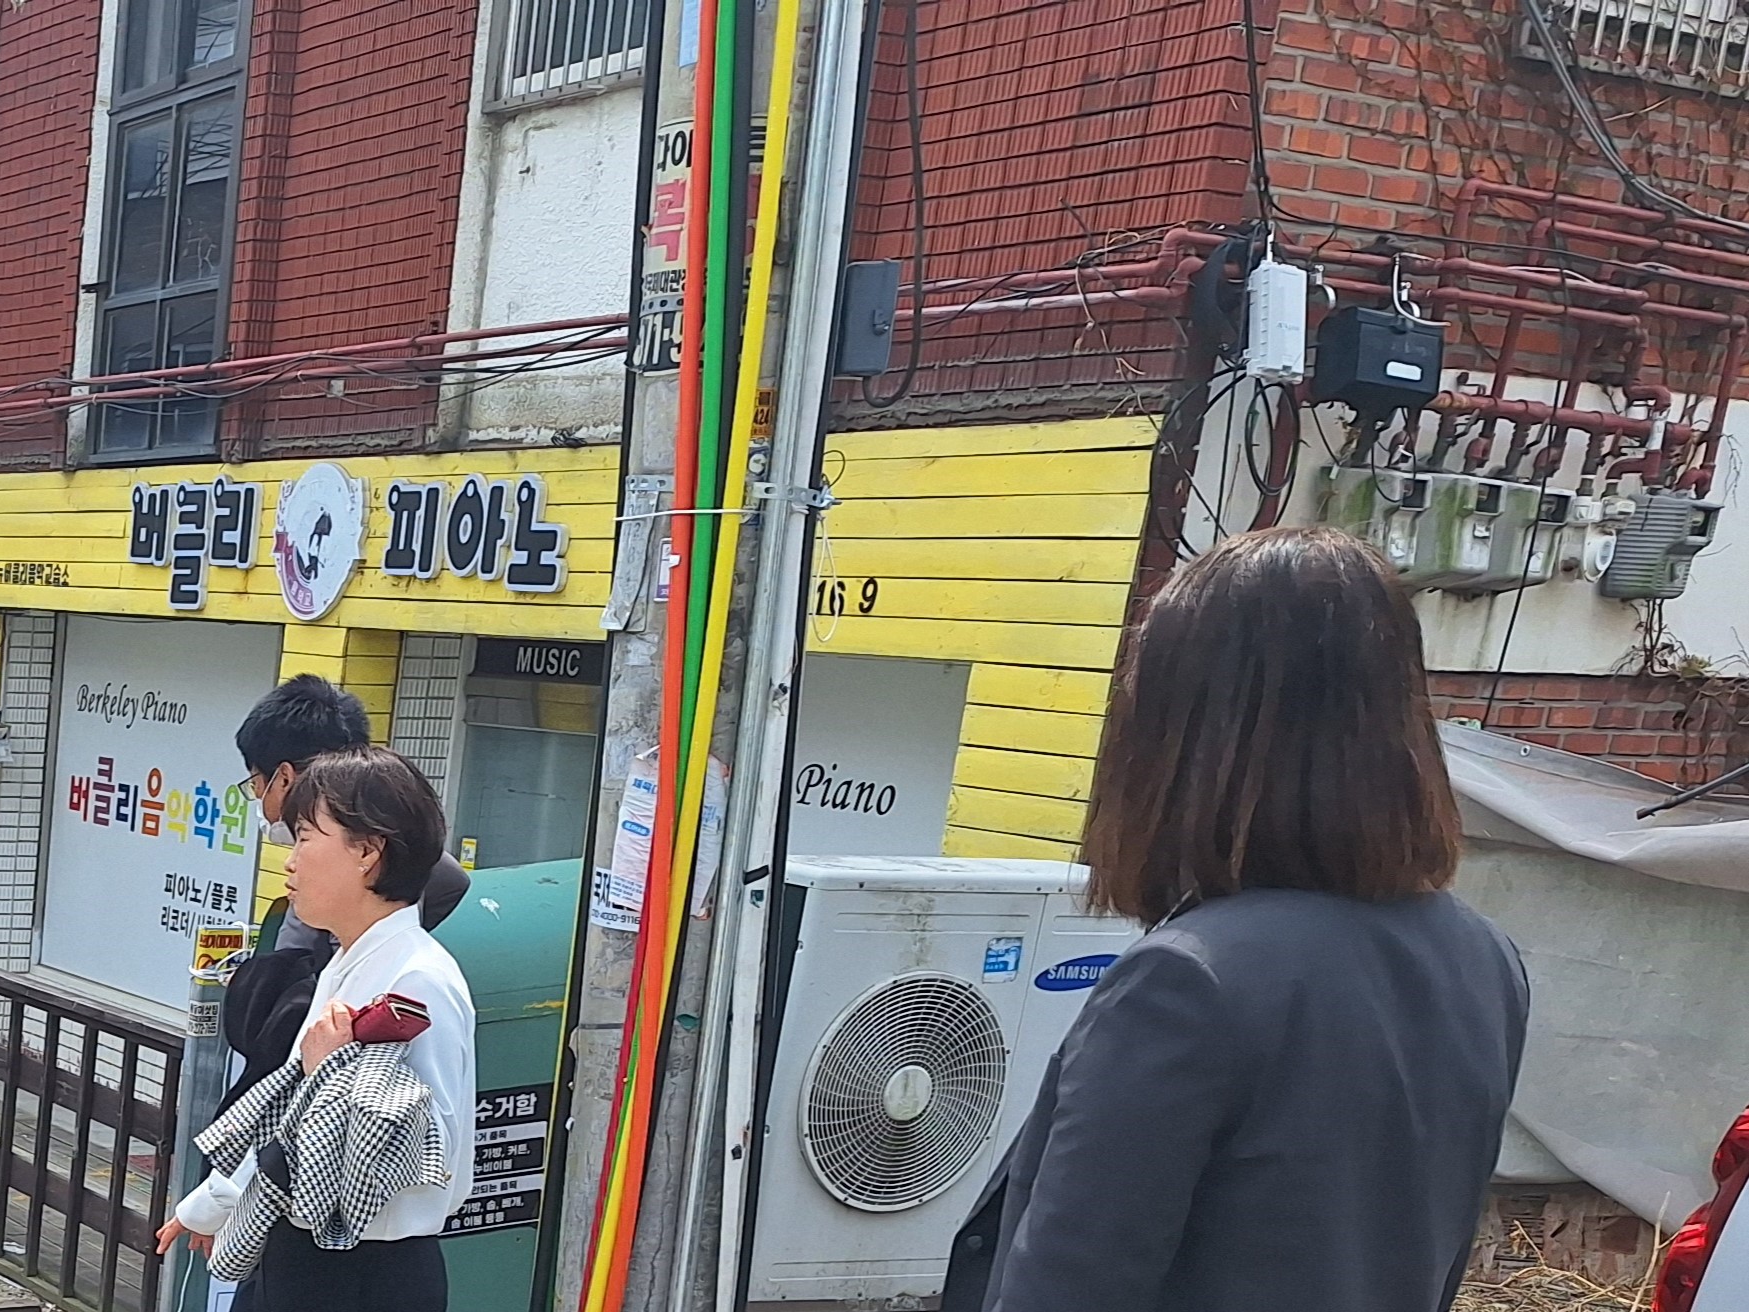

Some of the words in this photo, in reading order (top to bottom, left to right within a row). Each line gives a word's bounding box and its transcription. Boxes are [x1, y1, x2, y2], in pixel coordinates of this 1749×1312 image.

[129, 474, 260, 610] 버클리
[383, 473, 569, 593] 피아노
[516, 645, 581, 678] MUSIC
[76, 683, 140, 729] Berkeley
[141, 690, 188, 727] Piano
[69, 755, 248, 855] 버클리음악학원
[795, 762, 897, 816] Piano
[1047, 964, 1110, 981] SAMSUN
[475, 1092, 537, 1122] 수거함
[490, 1129, 507, 1141] 품목
